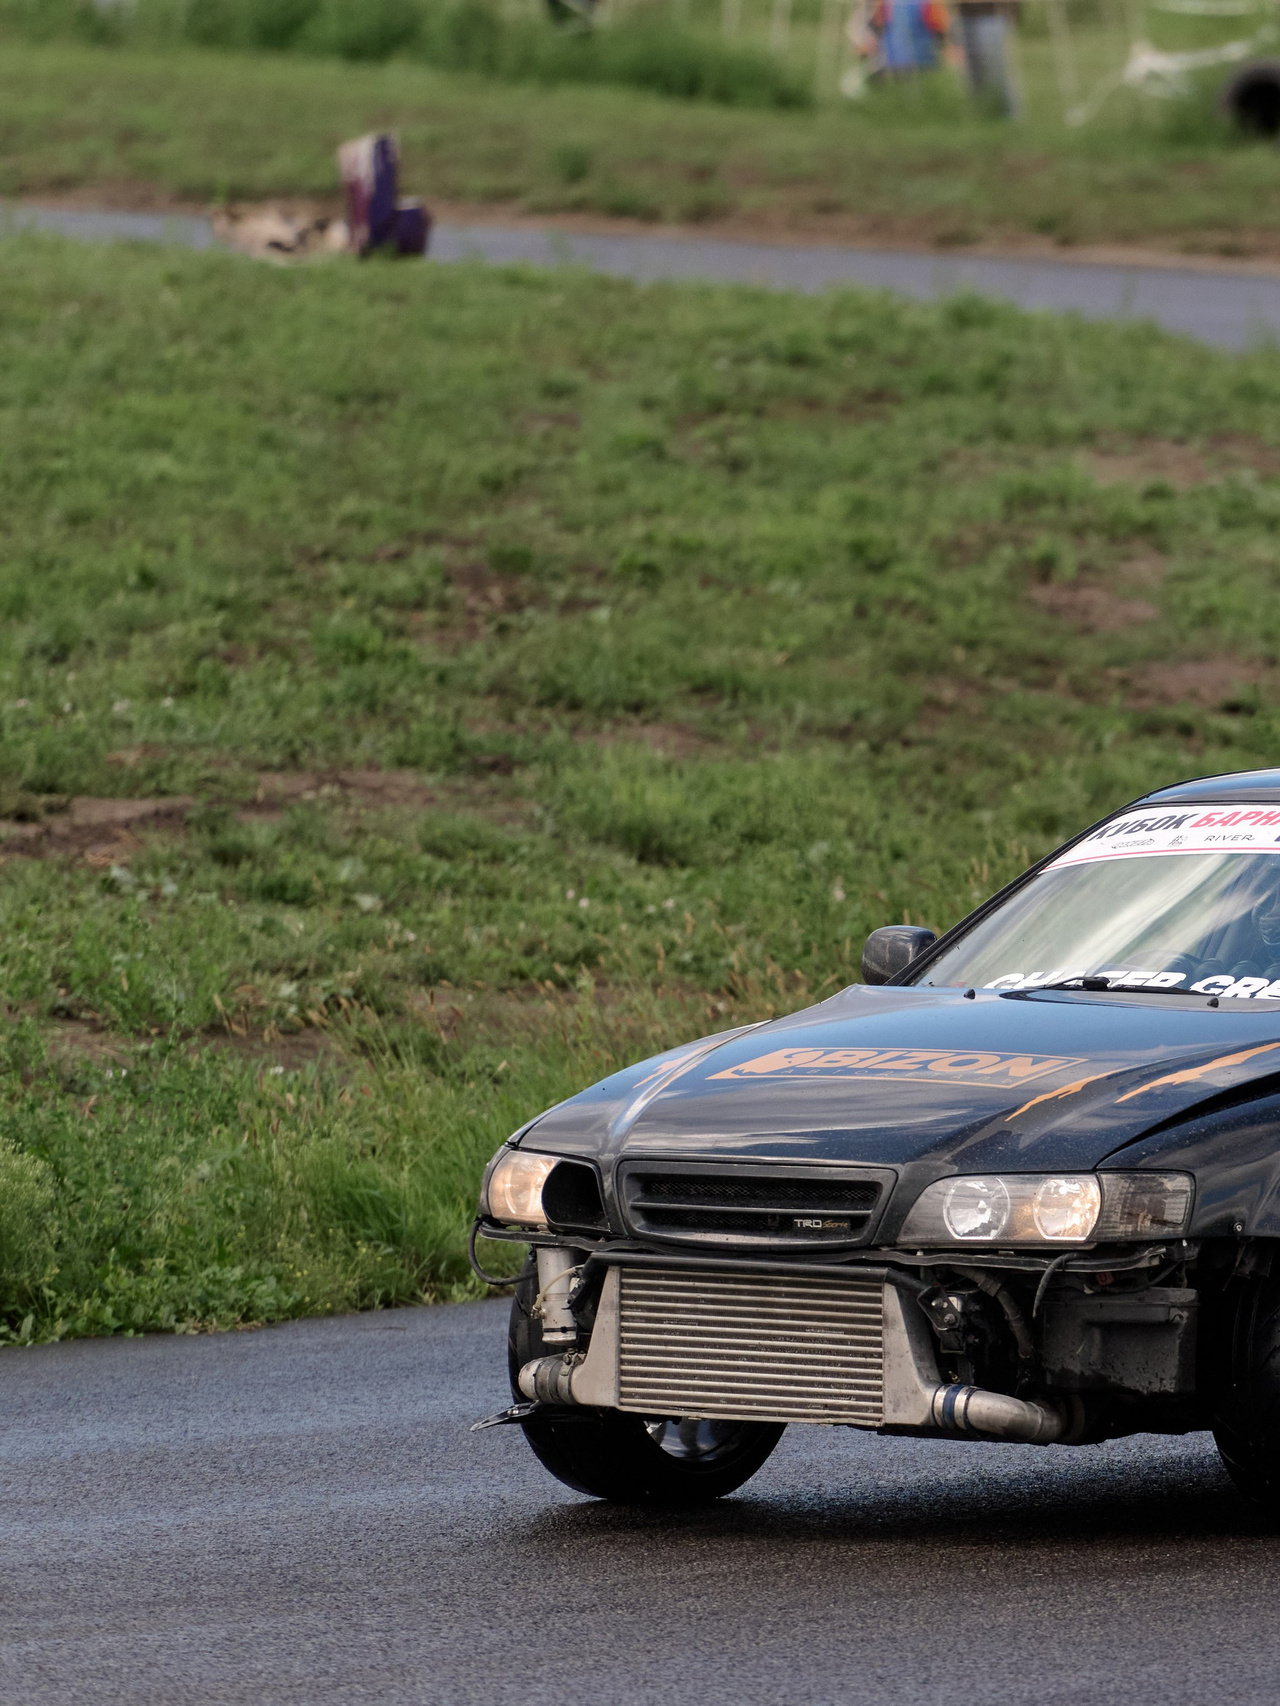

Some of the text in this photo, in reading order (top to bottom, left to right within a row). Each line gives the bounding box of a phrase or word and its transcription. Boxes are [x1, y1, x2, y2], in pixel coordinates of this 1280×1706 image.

[1088, 813, 1200, 842] КУБОК
[1204, 834, 1256, 842] RIVER
[795, 1050, 1067, 1077] BIZON
[794, 1219, 822, 1228] TRD
